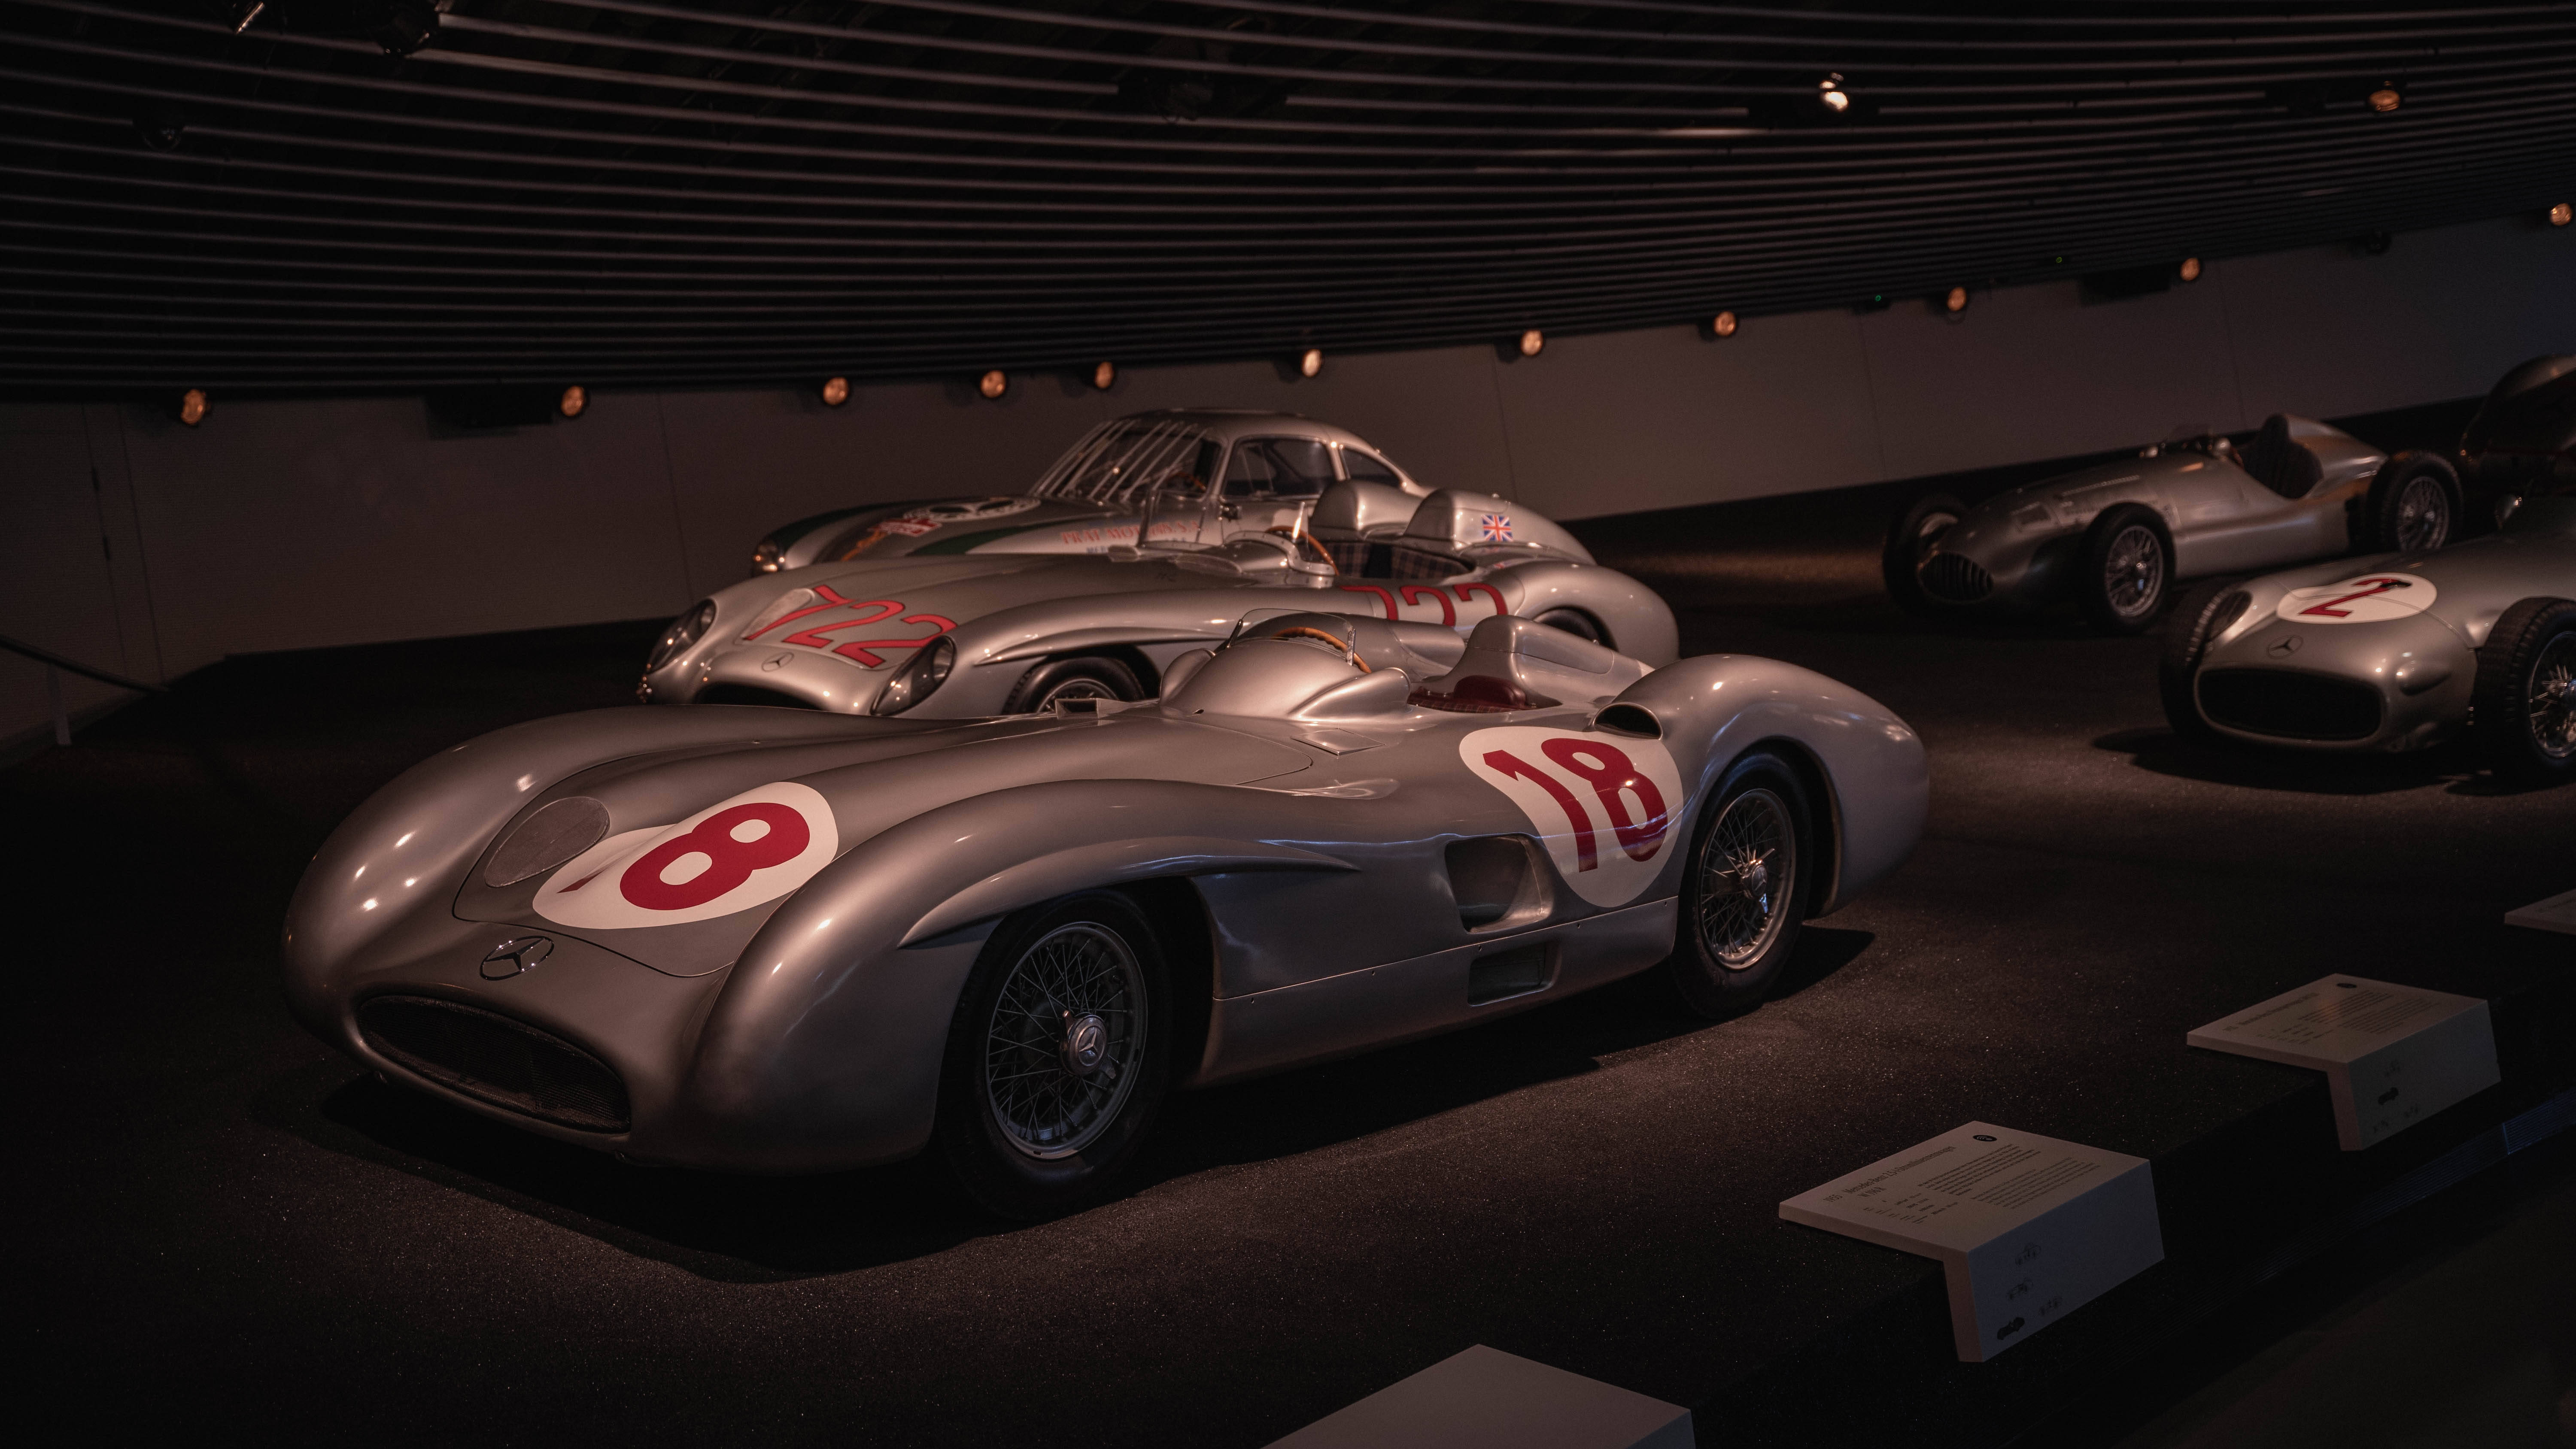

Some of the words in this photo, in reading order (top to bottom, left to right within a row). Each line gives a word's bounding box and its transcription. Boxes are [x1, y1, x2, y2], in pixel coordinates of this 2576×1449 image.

[744, 585, 958, 668] 722
[2300, 578, 2400, 617] 2
[1482, 738, 1668, 873] 18
